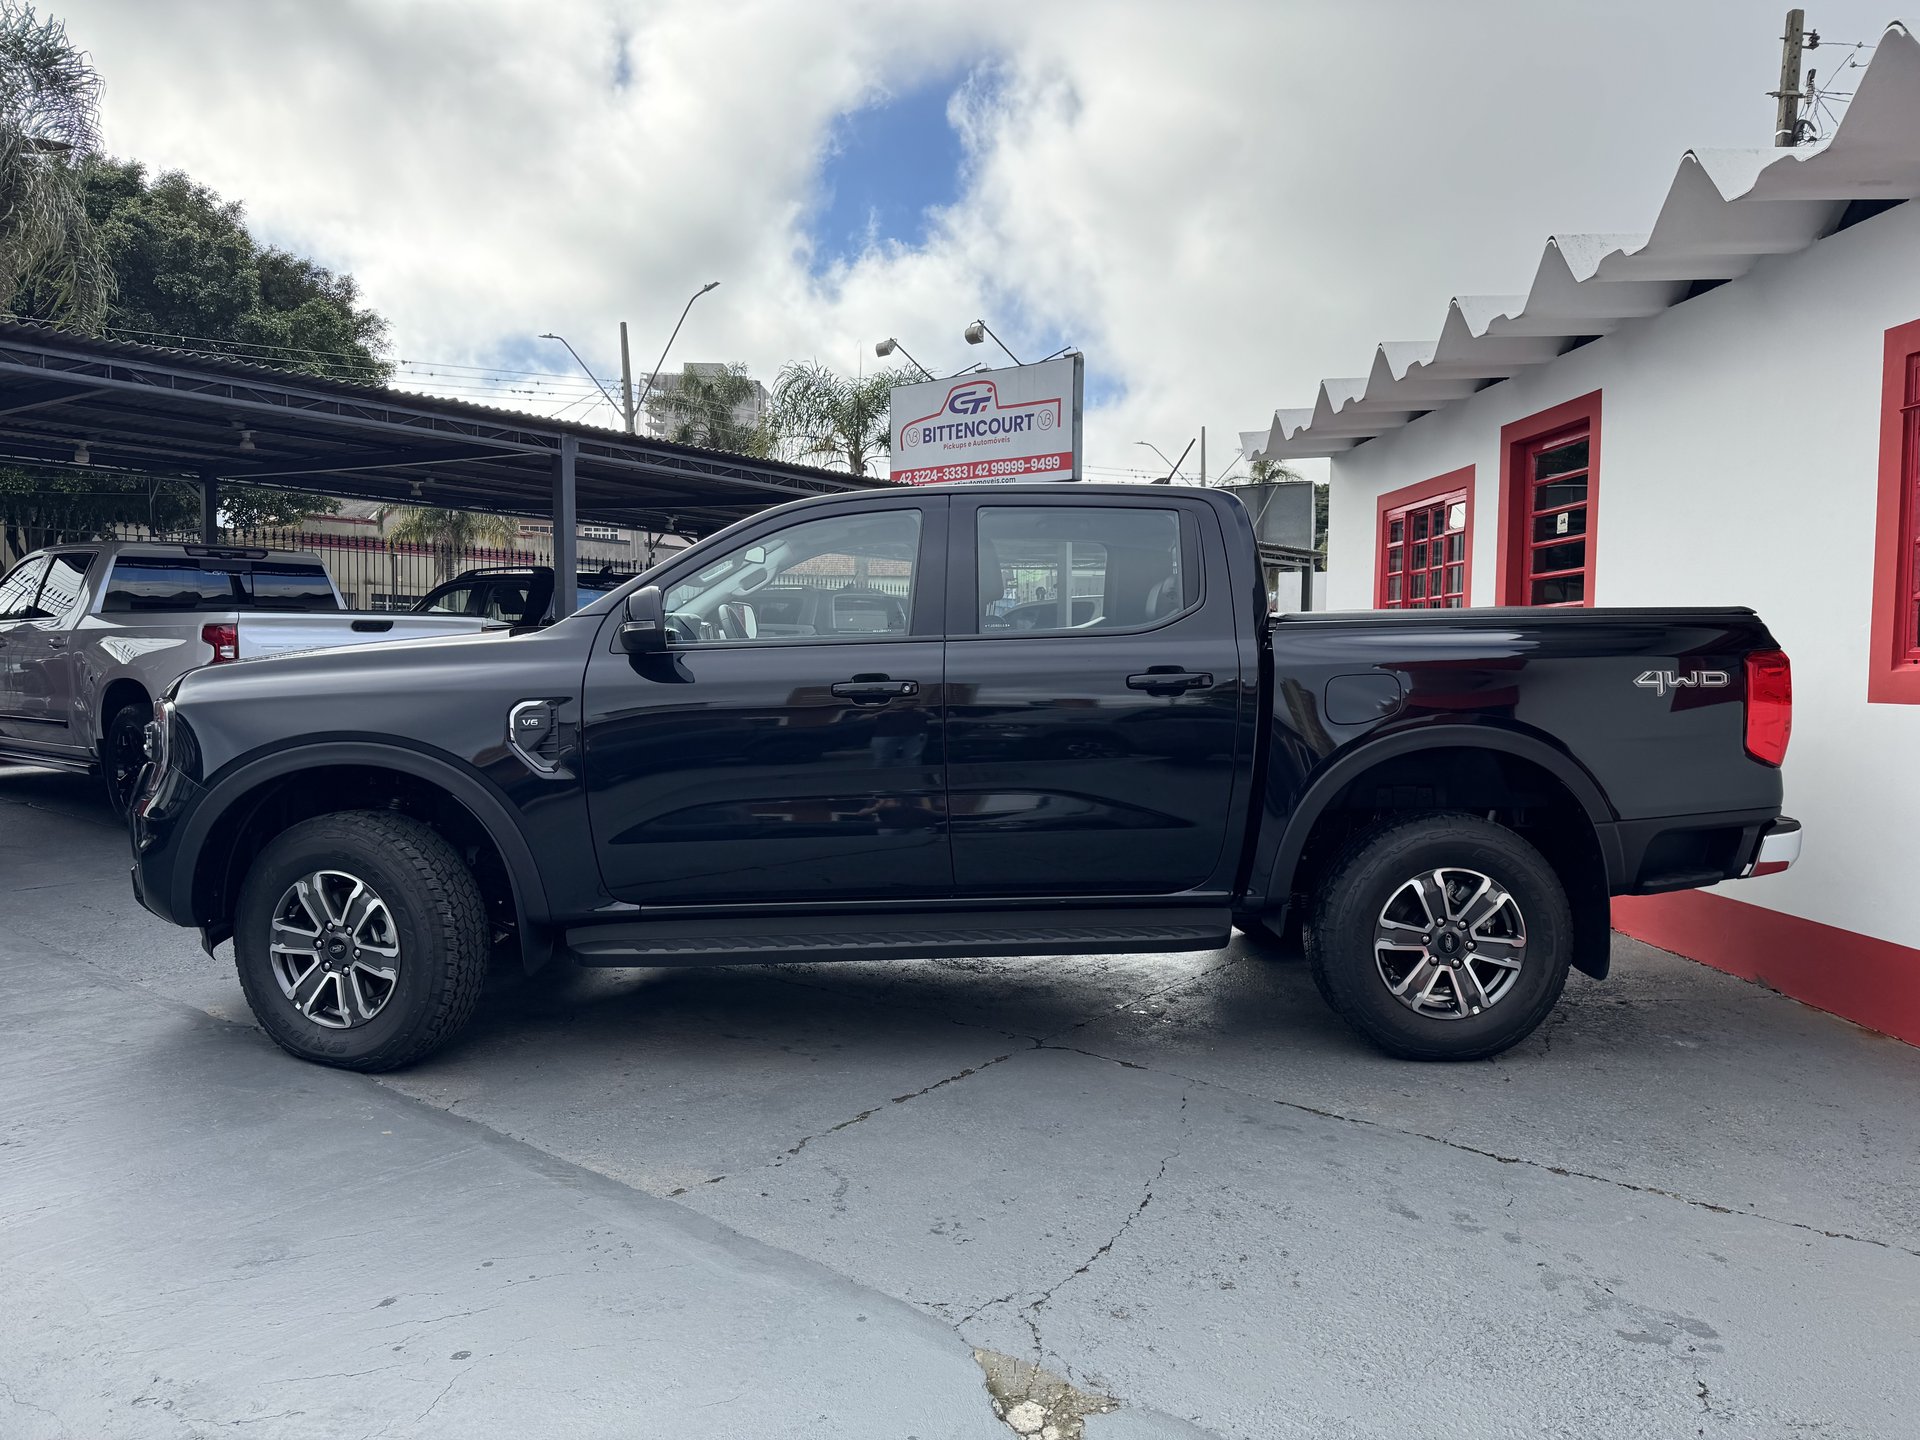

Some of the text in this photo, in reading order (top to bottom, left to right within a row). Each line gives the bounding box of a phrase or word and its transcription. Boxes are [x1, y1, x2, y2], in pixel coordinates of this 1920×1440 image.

[922, 413, 1035, 444] BITTENCOURT
[943, 443, 967, 451] Pickups
[973, 436, 1010, 446] Automóveis
[899, 472, 912, 484] 42
[913, 466, 968, 484] 3224-3333
[975, 463, 989, 476] 42
[991, 456, 1060, 474] 99999-9499
[1632, 670, 1731, 697] 4WD
